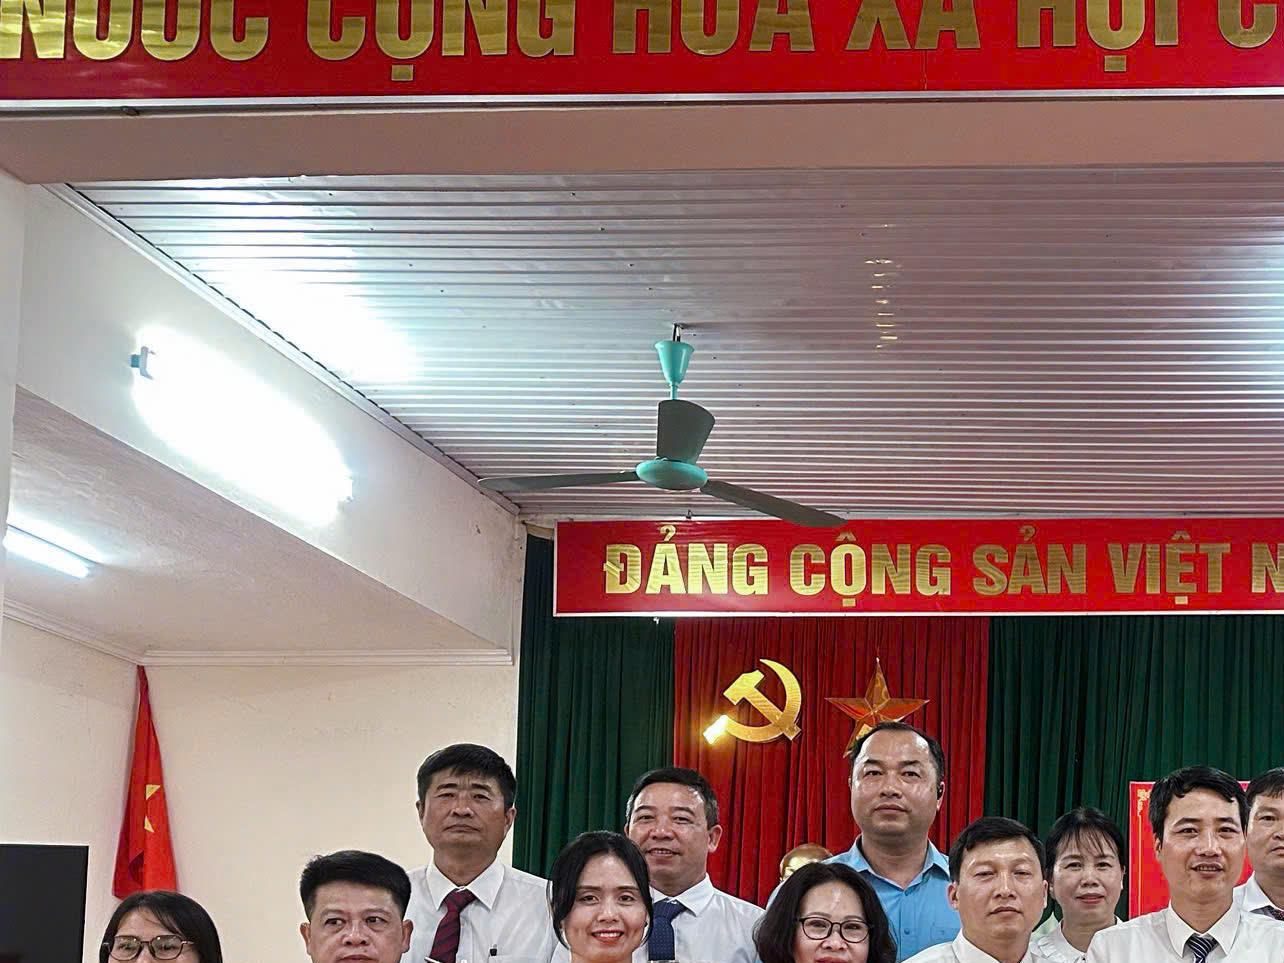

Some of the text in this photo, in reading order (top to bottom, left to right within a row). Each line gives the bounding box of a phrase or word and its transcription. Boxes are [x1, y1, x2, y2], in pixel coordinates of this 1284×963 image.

[603, 525, 769, 596] ĐẢNG
[789, 531, 952, 607] CỘNG
[972, 525, 1087, 596] SẢN
[1108, 530, 1231, 605] VIỆT
